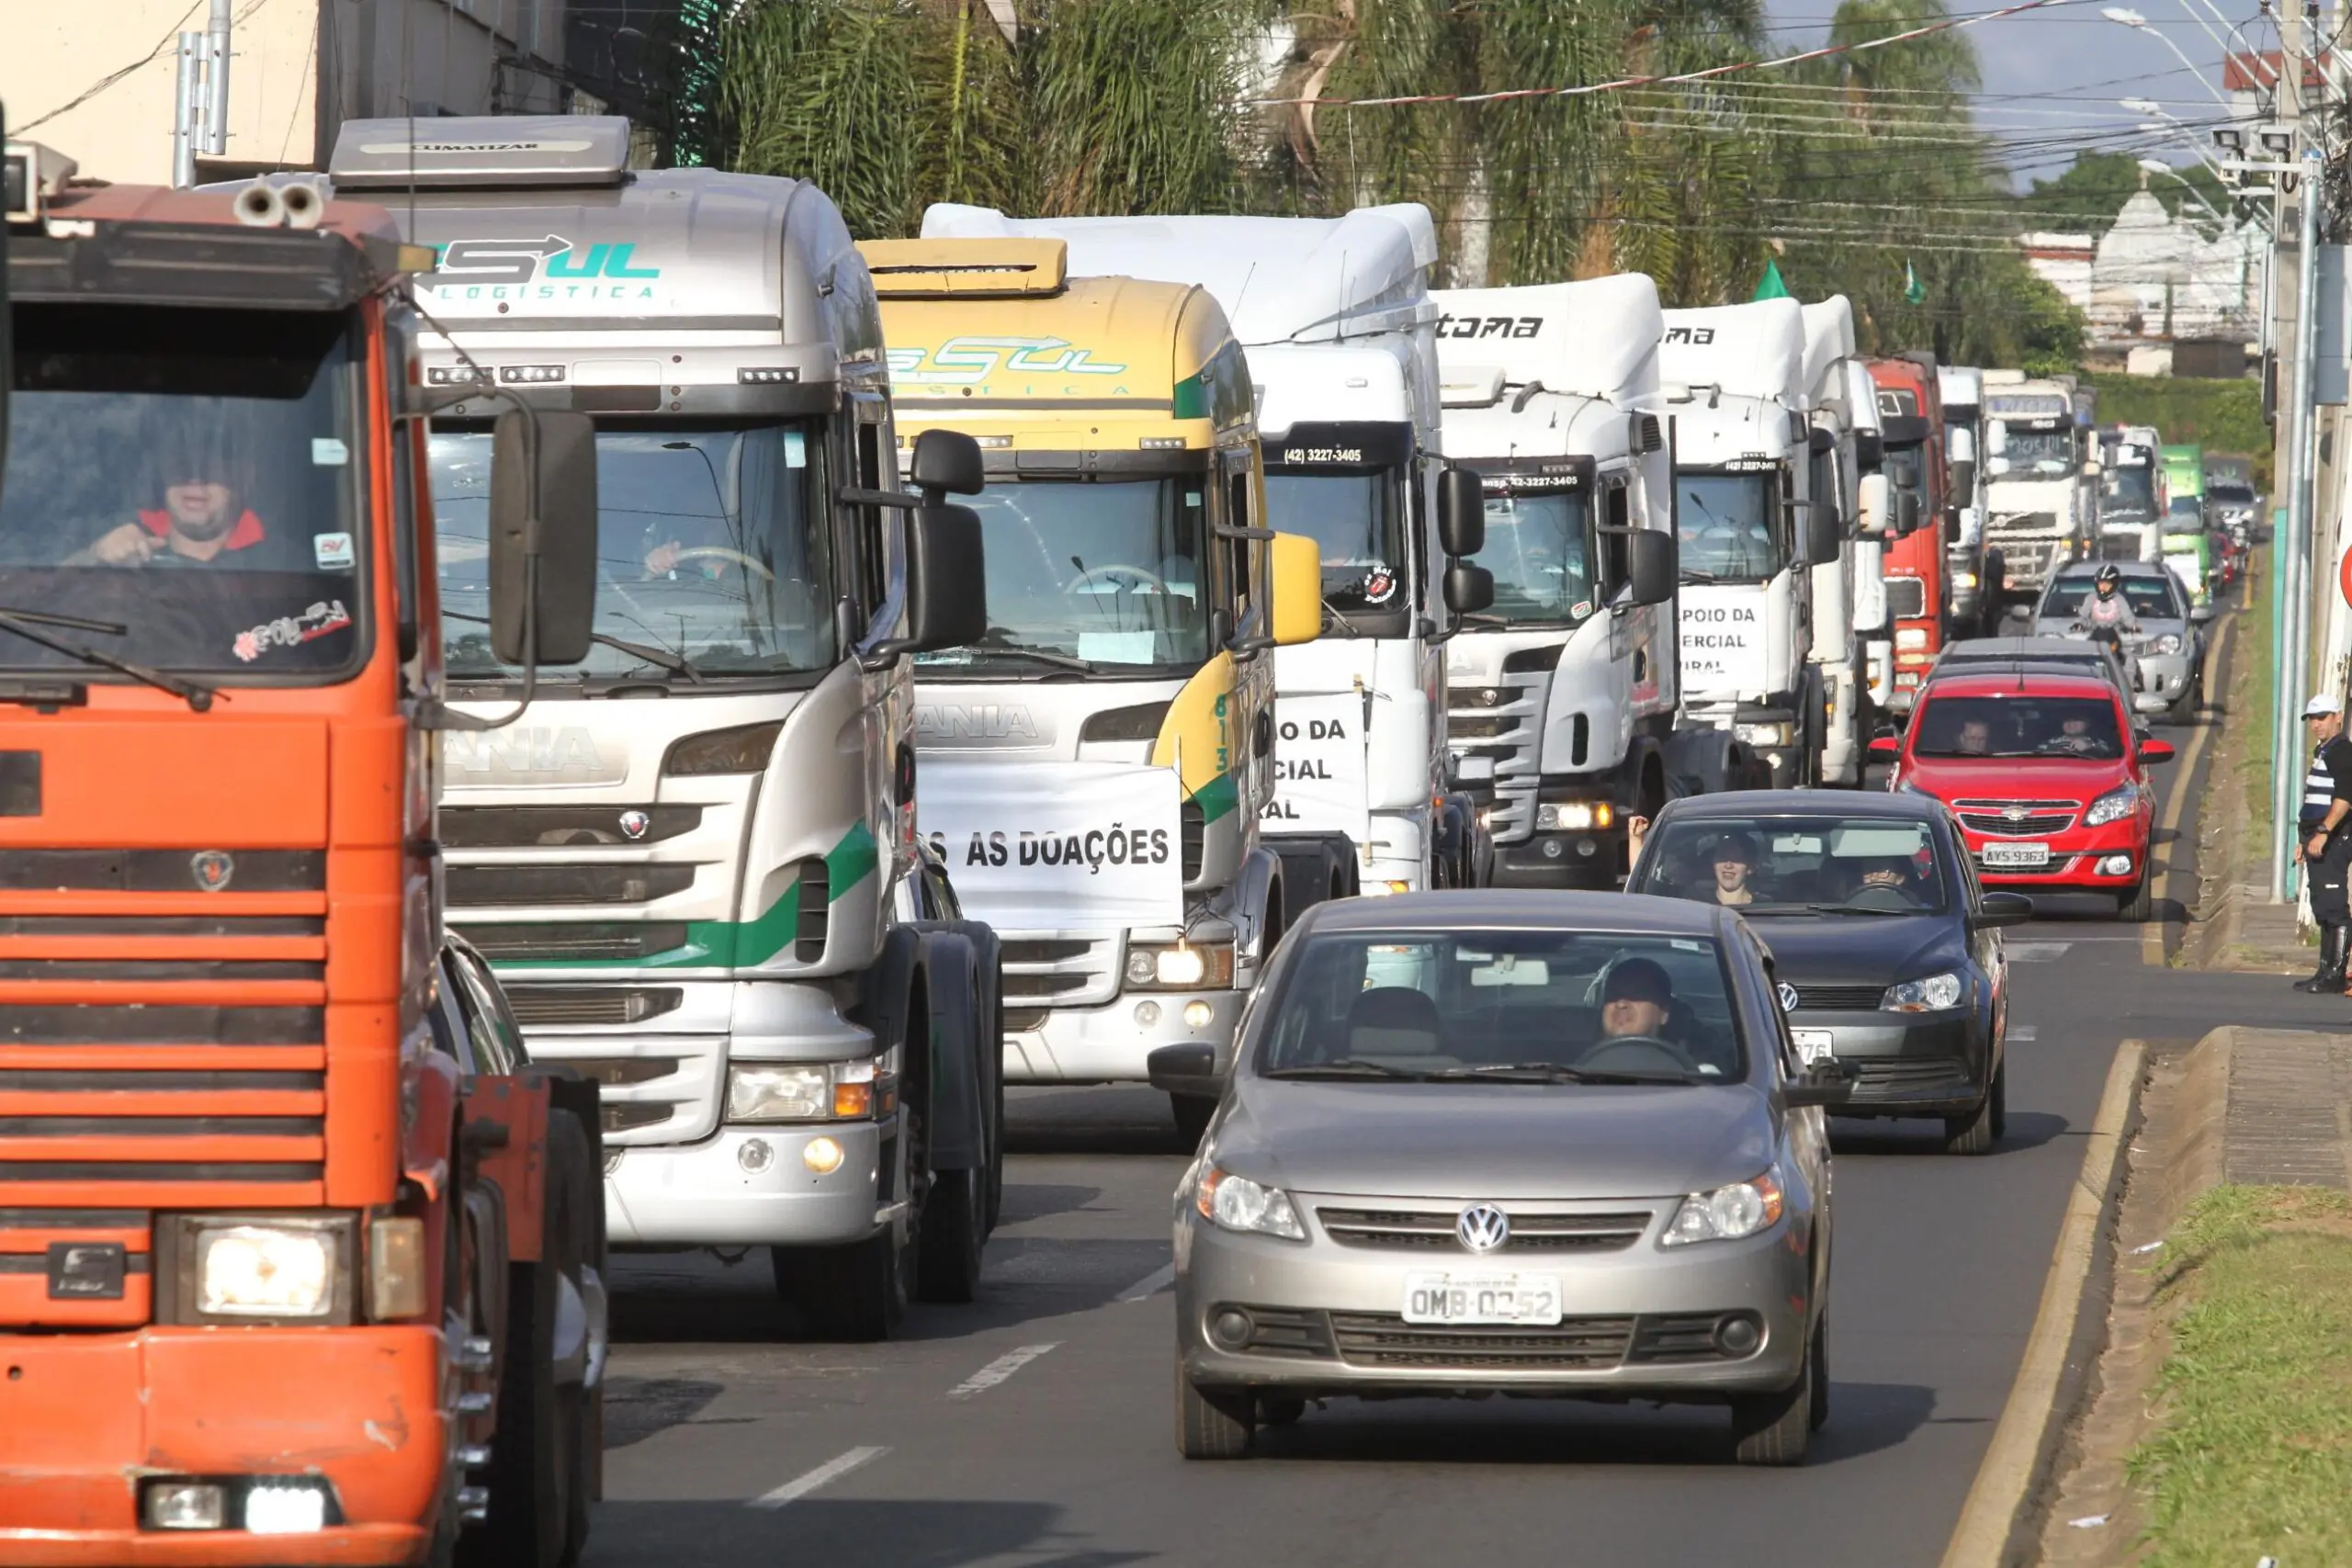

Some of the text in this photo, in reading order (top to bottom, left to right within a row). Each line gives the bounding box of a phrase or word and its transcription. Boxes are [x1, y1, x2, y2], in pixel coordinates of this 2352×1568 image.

[1435, 312, 1544, 339] toma
[1657, 327, 1715, 345] ma
[1283, 448, 1362, 465] (42) 3227-3405
[1679, 608, 1755, 623] POIO DA
[1682, 635, 1747, 648] ERCIAL
[1309, 718, 1346, 740] DA
[1258, 798, 1301, 819] AL
[967, 830, 1009, 867] AS
[1019, 822, 1170, 874] DOAÇÕES
